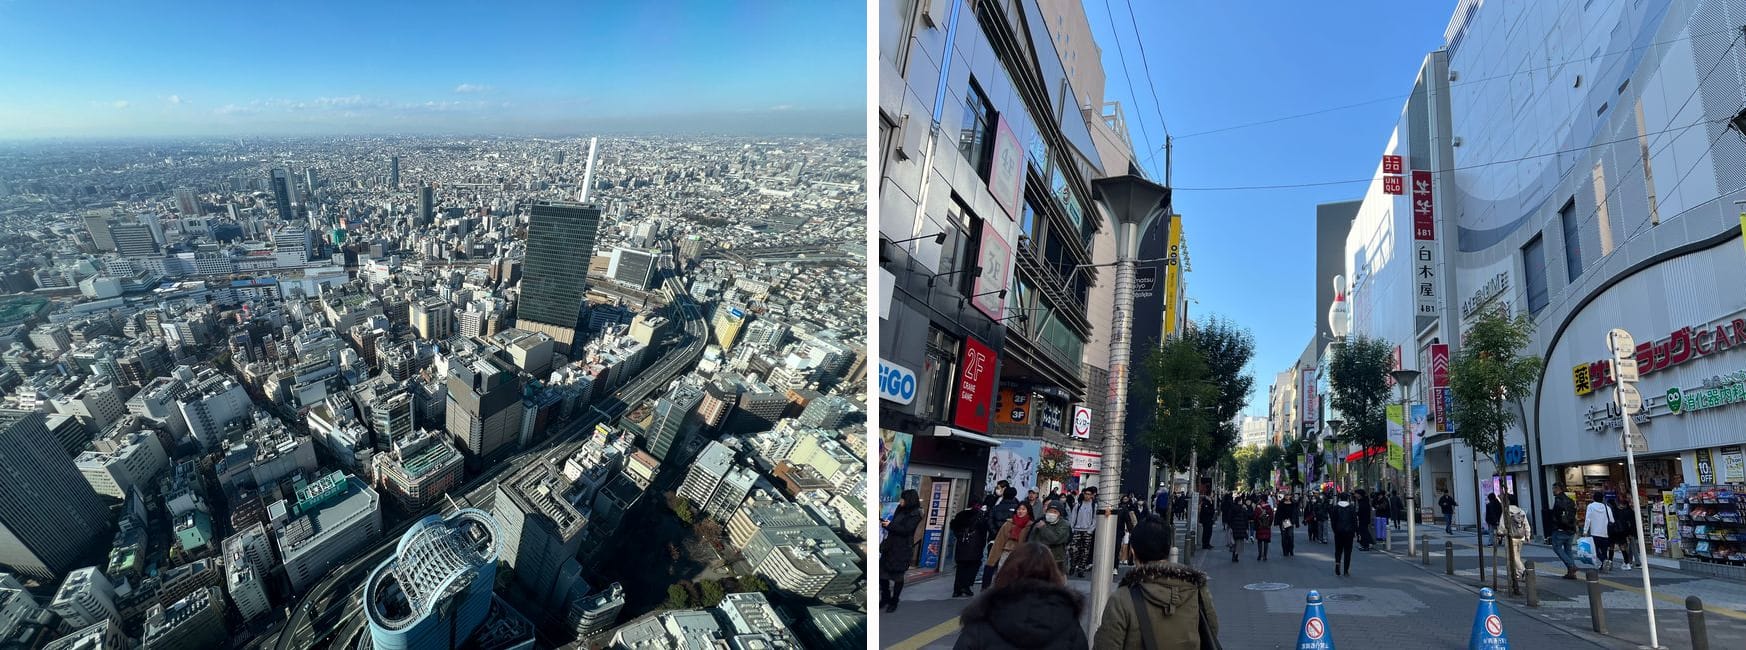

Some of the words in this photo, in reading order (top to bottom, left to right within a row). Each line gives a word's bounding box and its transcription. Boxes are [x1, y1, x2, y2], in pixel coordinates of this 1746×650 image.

[1419, 246, 1434, 296] 白木屋
[1425, 304, 1435, 312] B1
[1574, 366, 1589, 393] 薬
[1590, 325, 1691, 390] サラッグ
[964, 347, 986, 382] 2F
[961, 391, 974, 402] GAME
[1014, 394, 1026, 402] 2F
[1012, 411, 1025, 419] 3F
[1700, 474, 1713, 482] OFF
